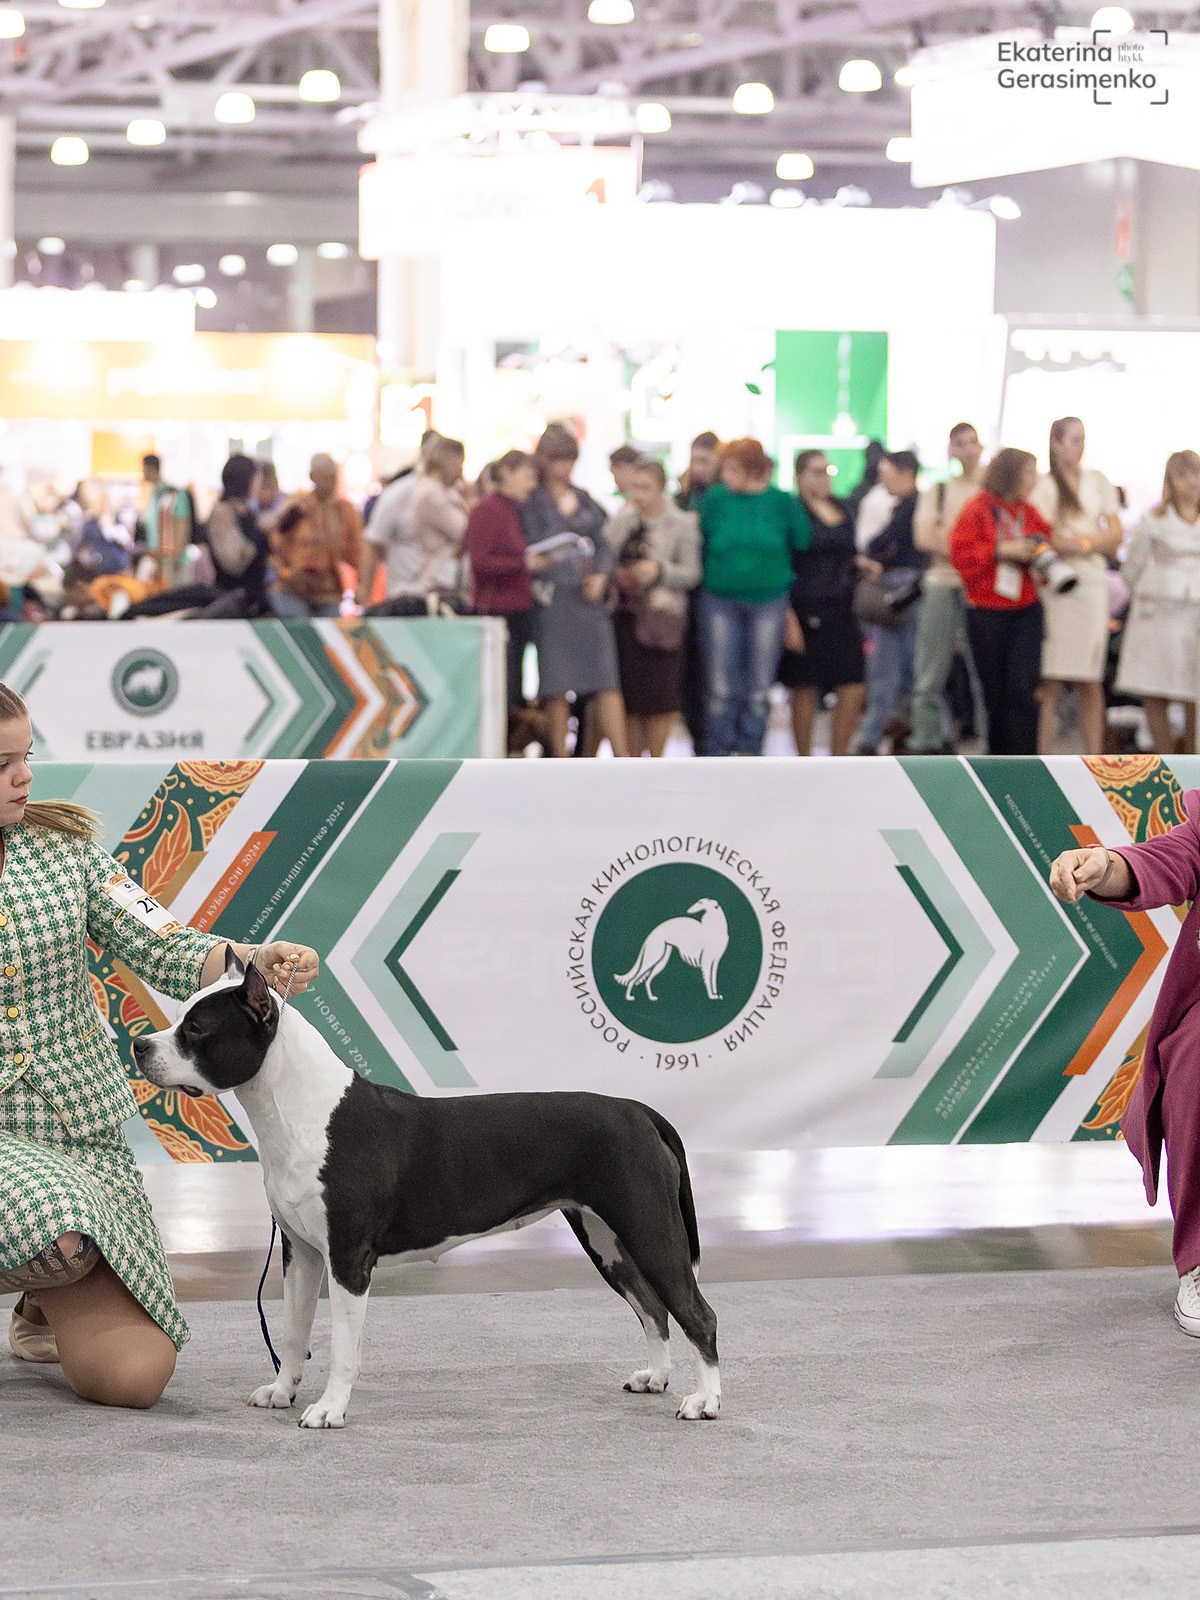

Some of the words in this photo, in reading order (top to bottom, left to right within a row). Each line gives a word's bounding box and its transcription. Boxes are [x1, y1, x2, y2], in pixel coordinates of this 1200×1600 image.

[207, 886, 231, 916] КУБОК
[249, 904, 275, 936] КУБОК
[270, 846, 316, 905] ПРЕЗИДЕНТА
[312, 825, 329, 846] РКФ
[591, 836, 781, 914] КИНОЛОГИЧЕСКАЯ
[566, 897, 631, 1053] РОССИЙСКАЯ
[723, 920, 788, 1052] ФЕДЕРАЦИЯ
[313, 995, 352, 1045] НОЯБРЯ
[349, 1046, 373, 1077] 2024
[655, 1052, 700, 1070] 1991
